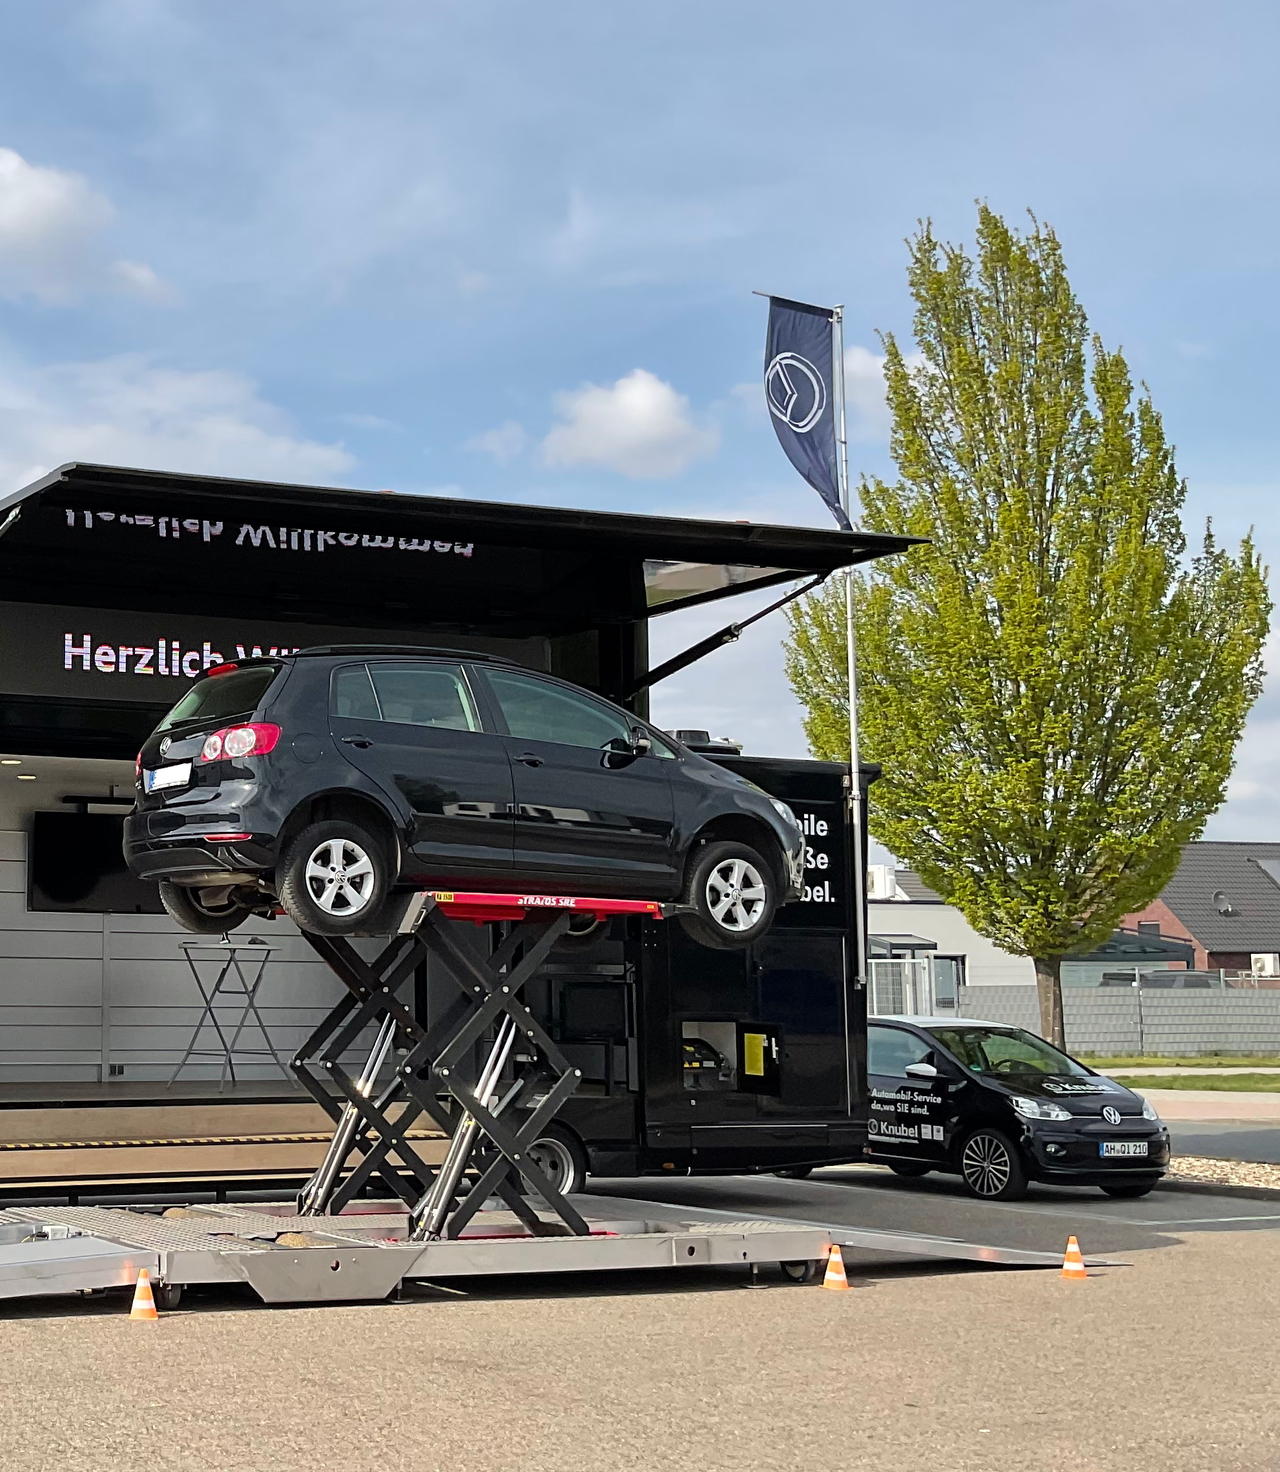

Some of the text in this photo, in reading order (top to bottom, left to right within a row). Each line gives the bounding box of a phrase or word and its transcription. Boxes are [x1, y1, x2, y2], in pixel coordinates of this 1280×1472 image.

[63, 632, 224, 678] Herzlich
[870, 1088, 942, 1104] Automobil-Service
[896, 1102, 909, 1113] SIE
[910, 1104, 930, 1115] sind.
[880, 1121, 918, 1138] Knubel
[1104, 1143, 1116, 1155] AH
